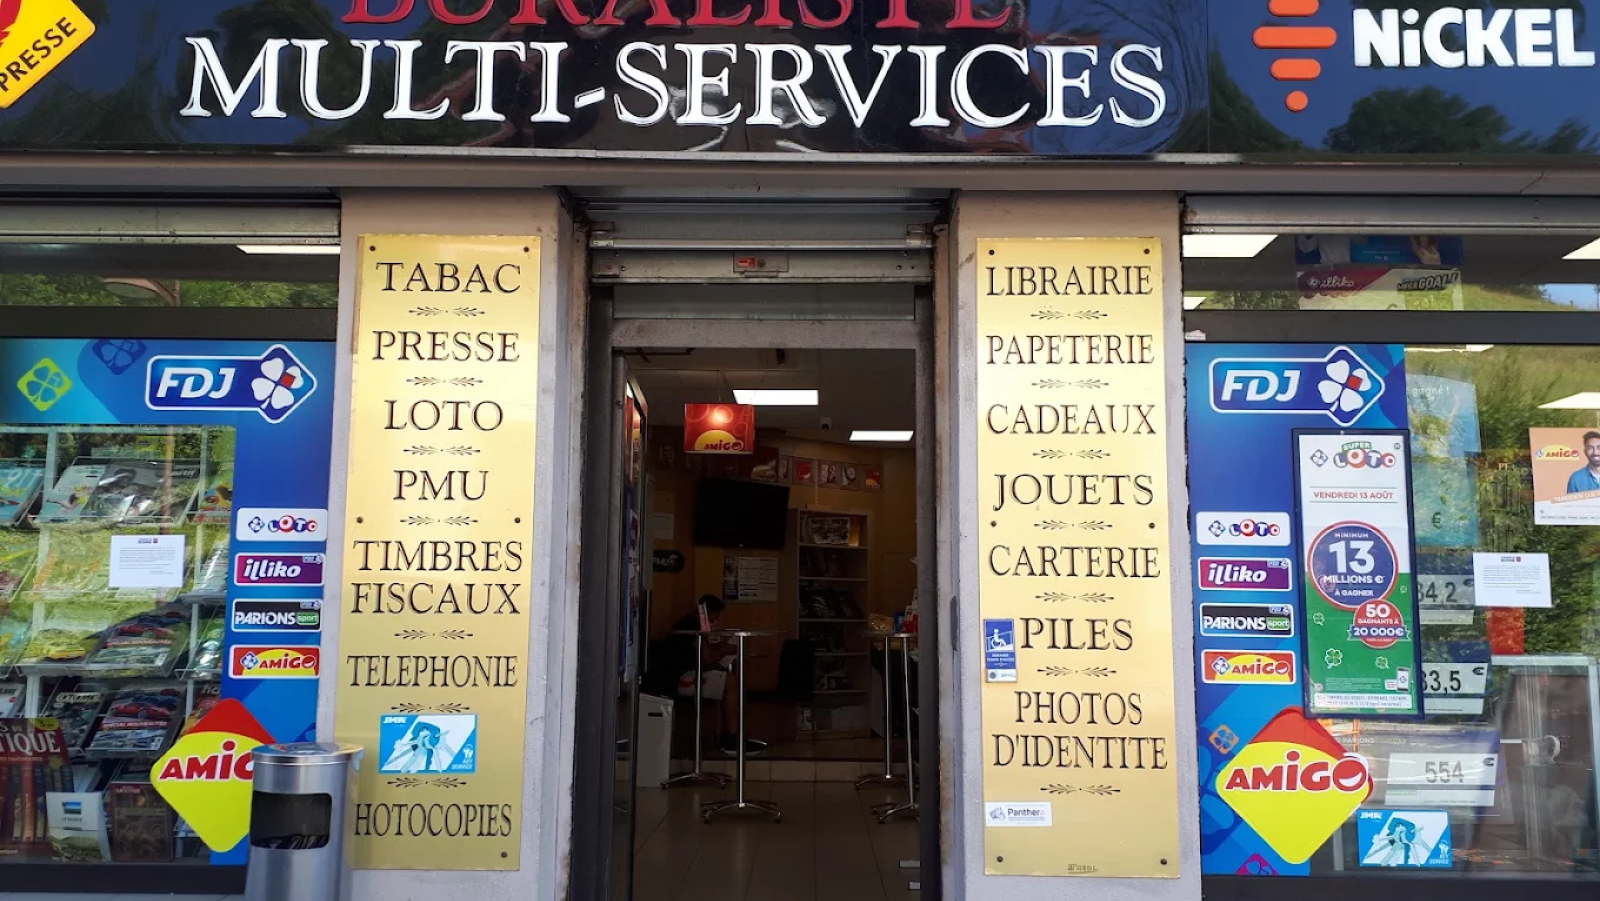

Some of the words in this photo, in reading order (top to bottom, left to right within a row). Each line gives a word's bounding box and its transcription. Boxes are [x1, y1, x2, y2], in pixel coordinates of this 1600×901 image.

[0, 17, 77, 92] PRESSE
[180, 37, 1166, 128] MULTI-SERVICES
[376, 262, 521, 293] TABAC
[986, 265, 1154, 296] LIBRAIRIE
[372, 330, 521, 362] PRESSE
[986, 334, 1155, 365] PAPETERIE
[156, 367, 236, 399] FDJ
[1221, 370, 1301, 402] FDJ
[384, 399, 504, 431] LOTO
[986, 404, 1157, 435] CADEAUX
[1333, 450, 1396, 469] LOTO
[1343, 441, 1372, 451] SUPER
[393, 470, 489, 501] PMU
[993, 474, 1154, 511] JOUETS
[1313, 491, 1358, 499] VENDREDI
[1369, 490, 1394, 499] AOÛT
[268, 515, 318, 533] LOTO
[1229, 519, 1280, 537] LOTO
[243, 558, 301, 581] illiko
[353, 540, 523, 572] TIMBRES
[989, 545, 1161, 578] CARTERIE
[1328, 541, 1375, 574] 13
[1207, 562, 1267, 585] illiko
[1324, 575, 1373, 584] MILLIONS
[1374, 575, 1385, 584] €
[351, 583, 521, 614] FISCAUX
[1366, 604, 1391, 618] 50
[235, 612, 296, 625] PARIONS
[1020, 617, 1133, 650] PILES
[1203, 616, 1267, 630] PARIONS
[1267, 618, 1289, 627] sport
[1353, 627, 1368, 636] 20
[347, 655, 519, 687] TELEPHONIE
[1014, 691, 1143, 725] PHOTOS
[992, 734, 1168, 769] D'IDENTITE
[1425, 761, 1464, 784] 554
[1482, 757, 1495, 767] €
[354, 803, 512, 837] HOTOCOPIES
